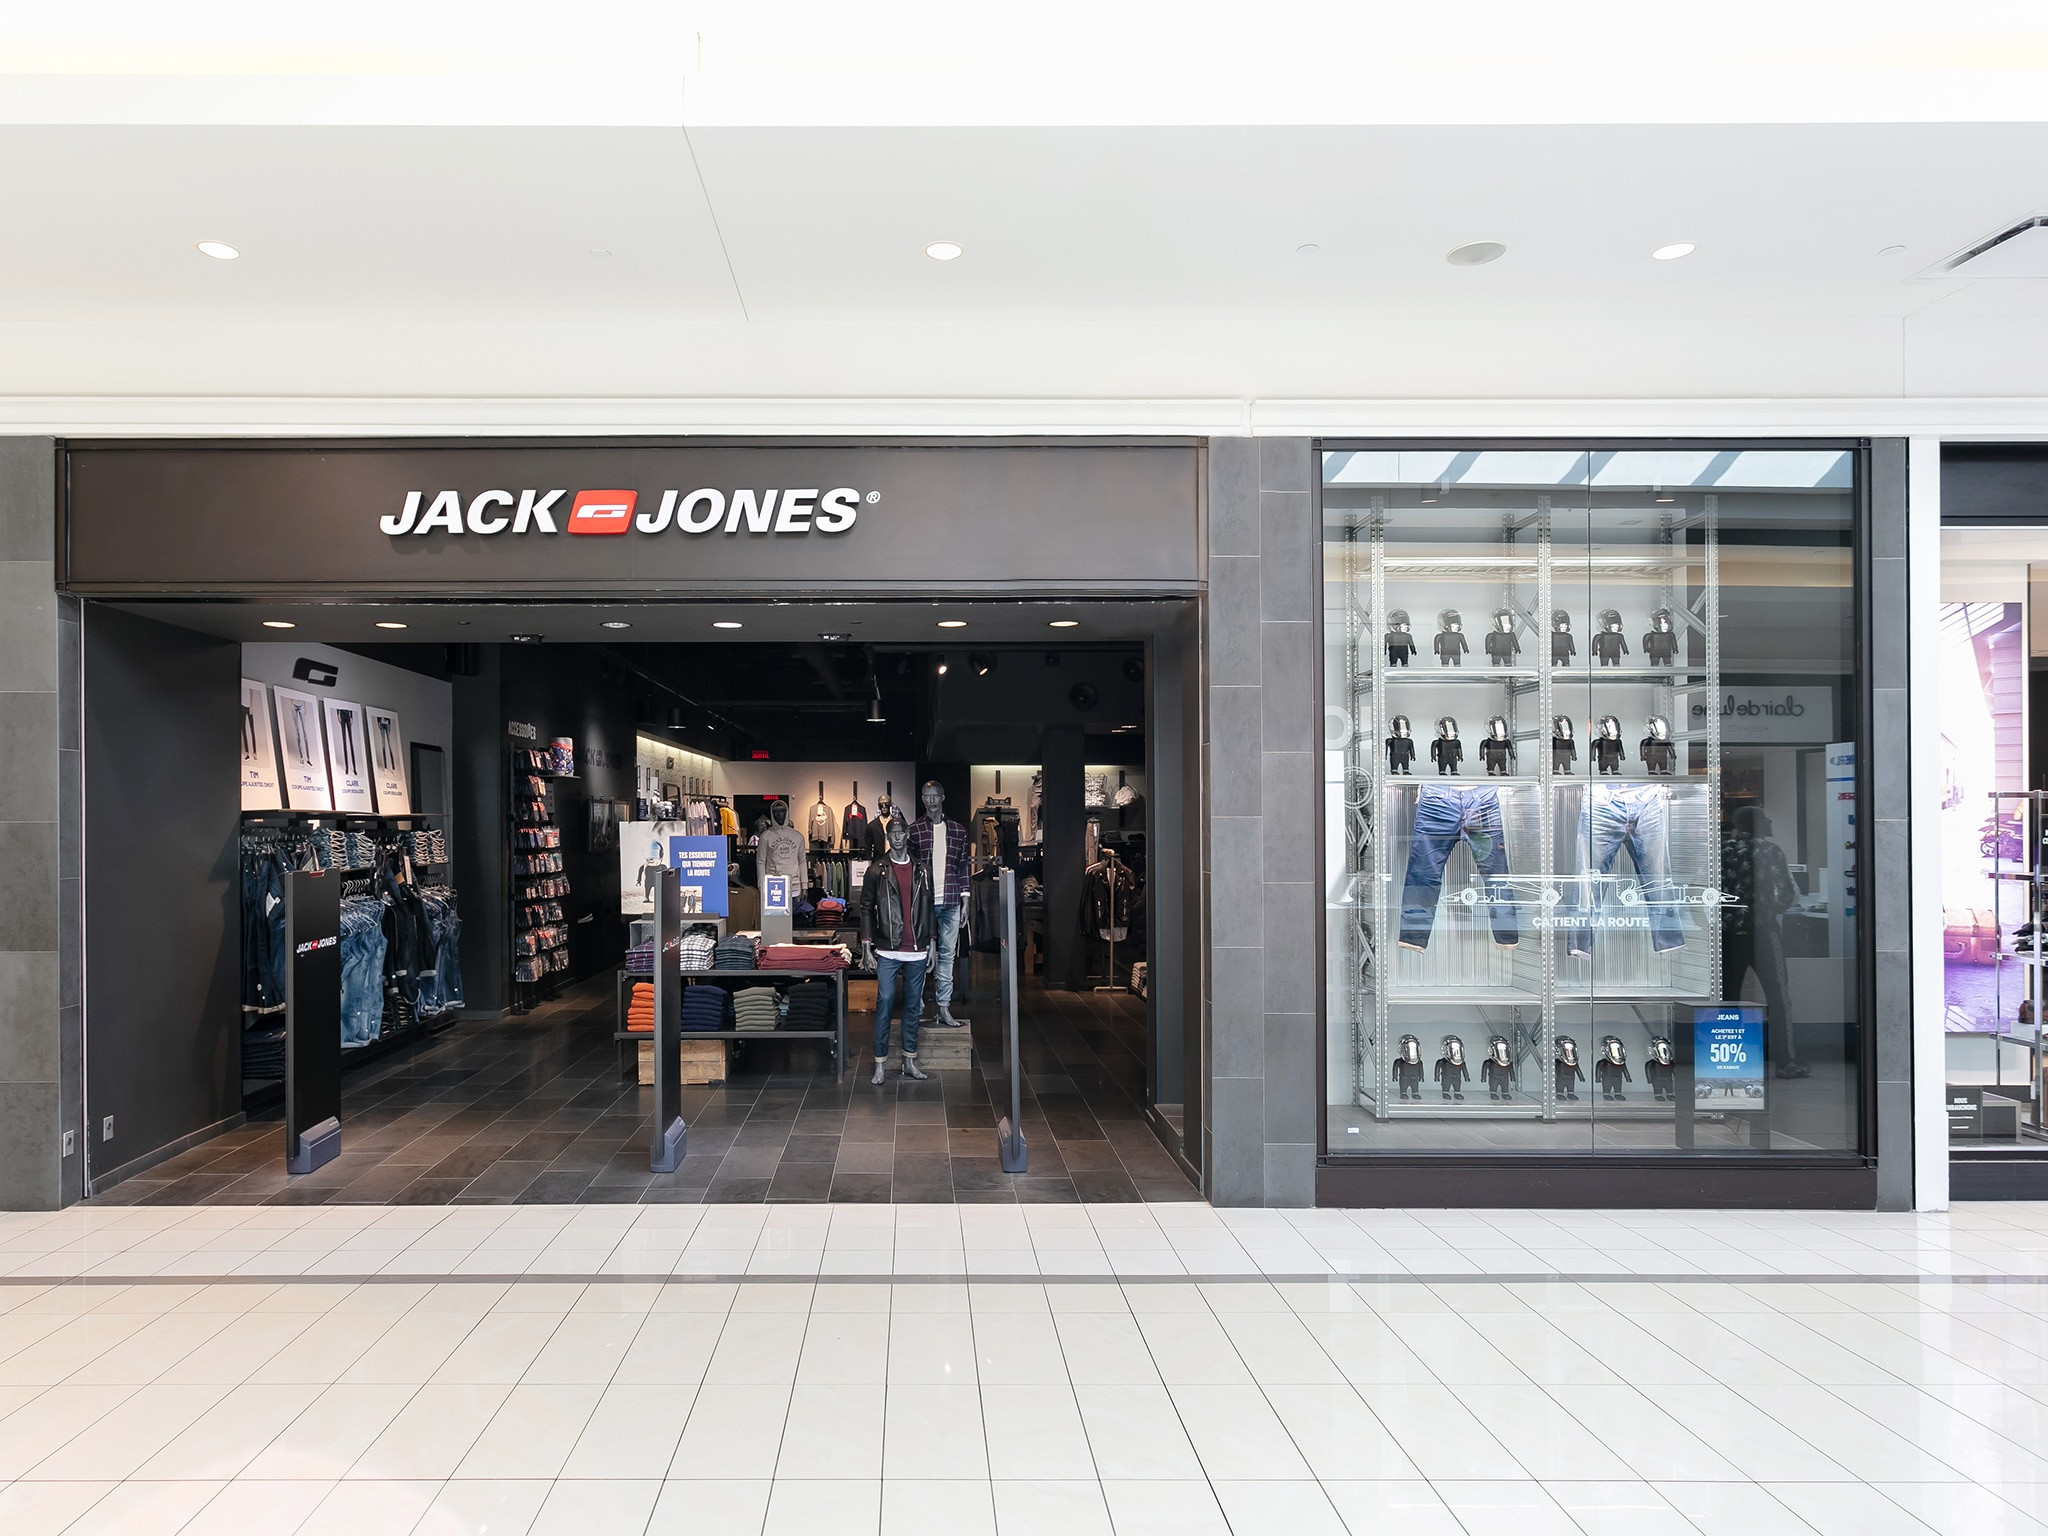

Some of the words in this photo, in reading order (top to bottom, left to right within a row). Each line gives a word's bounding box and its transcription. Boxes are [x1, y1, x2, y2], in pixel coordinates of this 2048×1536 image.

[379, 489, 568, 535] JACK
[249, 770, 260, 779] TIM
[303, 775, 313, 783] TIM
[345, 779, 360, 787] CLARK
[682, 860, 692, 868] QUI
[692, 860, 715, 868] TIENNENT
[687, 869, 693, 877] LA
[694, 869, 711, 877] ROUTE
[1532, 917, 1550, 930] ÇA
[1552, 917, 1588, 927] TIENT
[1590, 917, 1606, 927] LA
[1608, 917, 1650, 927] ROUTE
[297, 942, 312, 953] JACK
[318, 936, 337, 948] JONES
[1710, 1043, 1747, 1063] 50%
